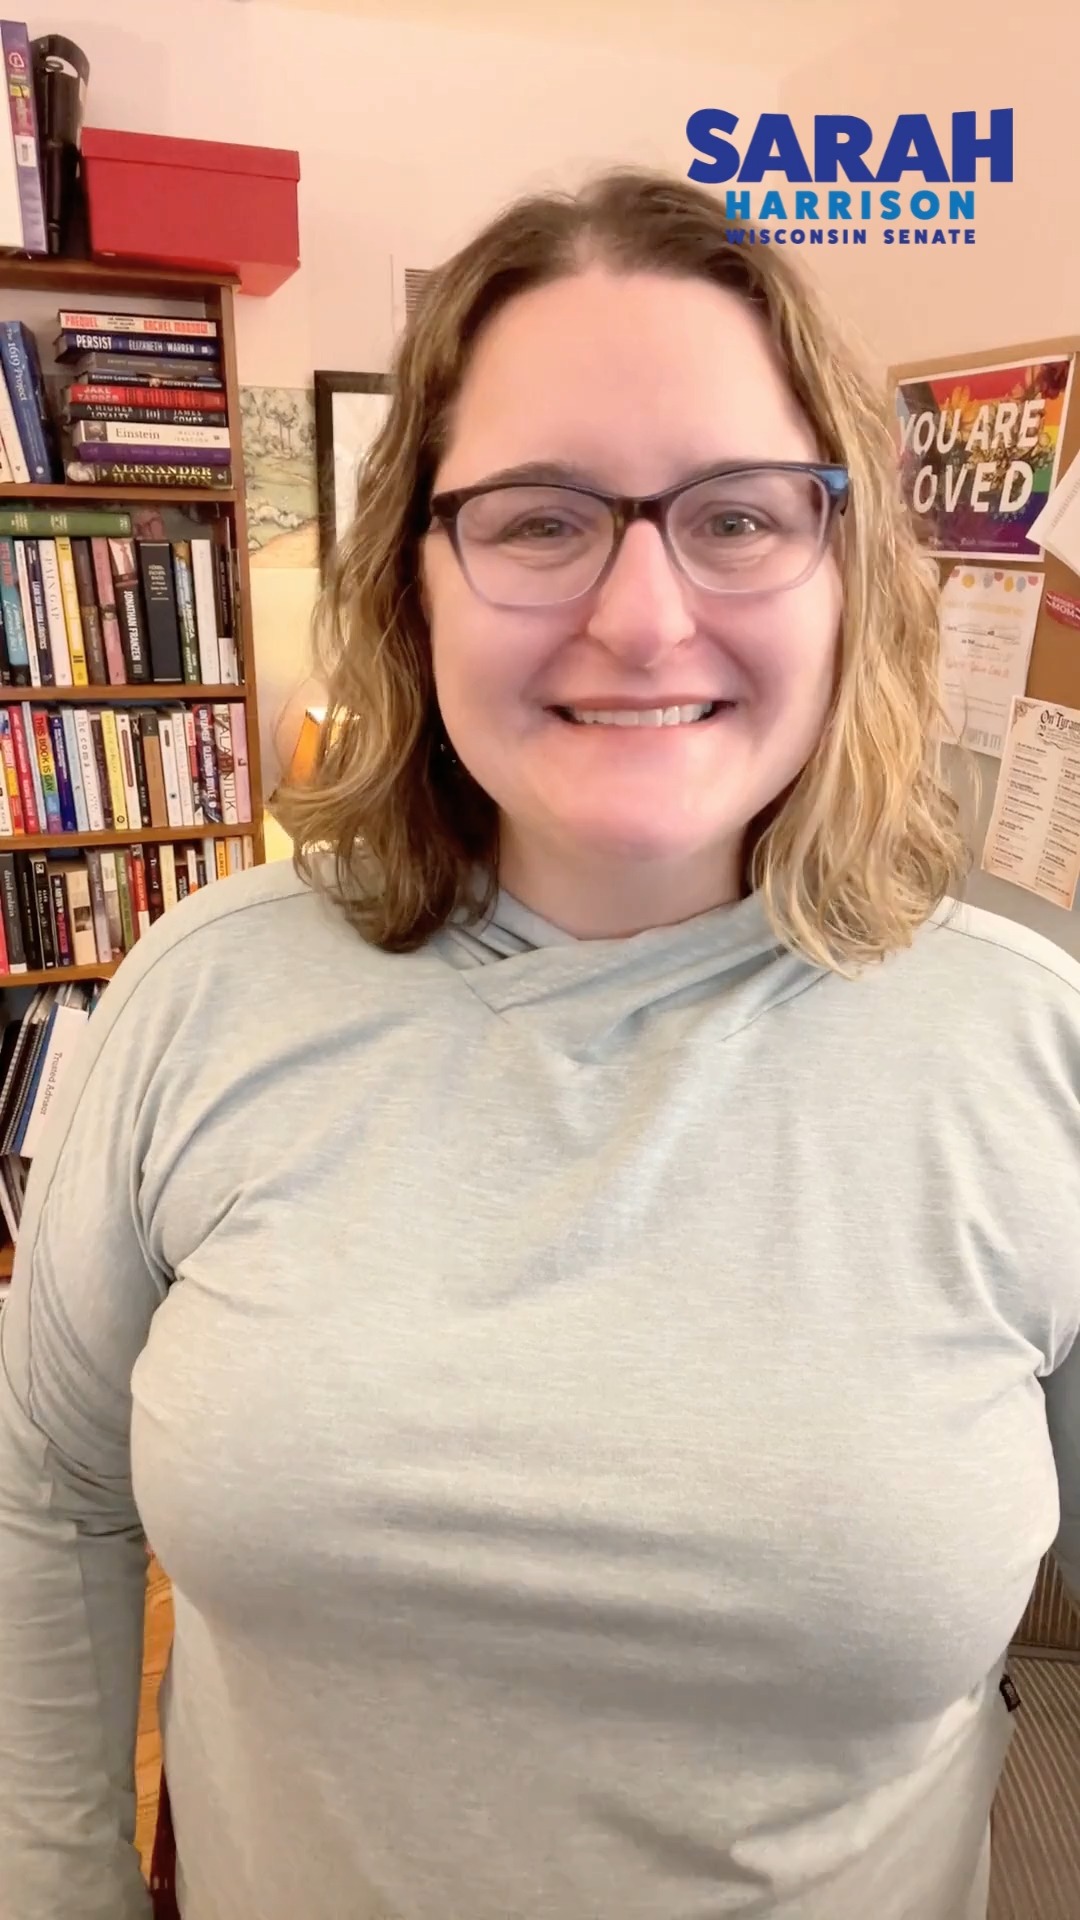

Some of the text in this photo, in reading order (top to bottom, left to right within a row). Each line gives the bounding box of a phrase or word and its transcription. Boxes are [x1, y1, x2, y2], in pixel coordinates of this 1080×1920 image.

[76, 334, 195, 354] PERSIST ELIZABETH WARREN
[116, 428, 160, 440] Einstein
[899, 398, 1046, 455] YOU ARE
[112, 463, 212, 476] ALEXANDER
[113, 474, 212, 486] HAMILTON
[901, 460, 1034, 513] OVED
[124, 591, 141, 661] JONATHAN FRANZEN
[186, 603, 196, 638] AMERICA
[35, 716, 55, 792] THIS BOOK IS GAY
[218, 712, 237, 812] PALAHNIUK
[4, 869, 15, 917] david sedaris
[40, 1051, 63, 1115] Trusted Advisor
